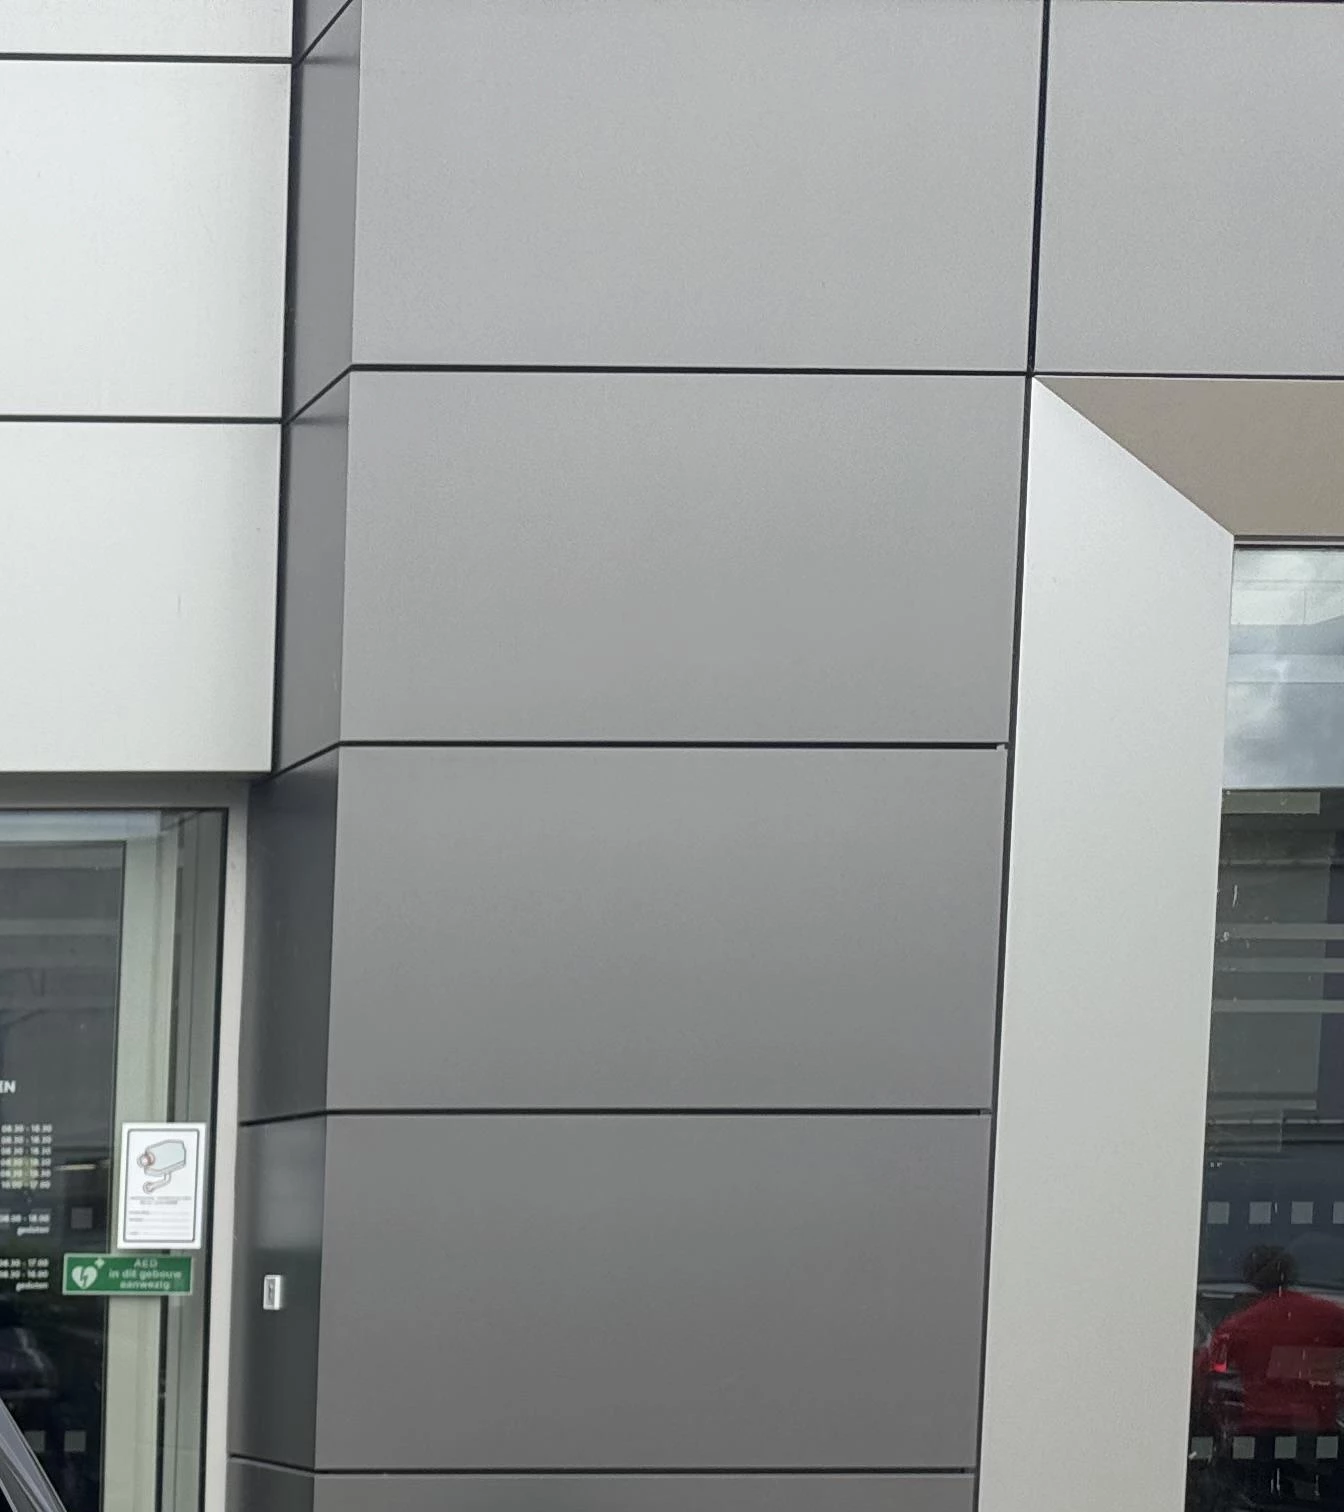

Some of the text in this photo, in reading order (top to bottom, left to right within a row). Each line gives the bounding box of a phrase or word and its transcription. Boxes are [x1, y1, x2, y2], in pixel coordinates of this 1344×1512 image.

[133, 1258, 158, 1268] AED
[108, 1270, 120, 1278] in
[122, 1269, 136, 1279] dit
